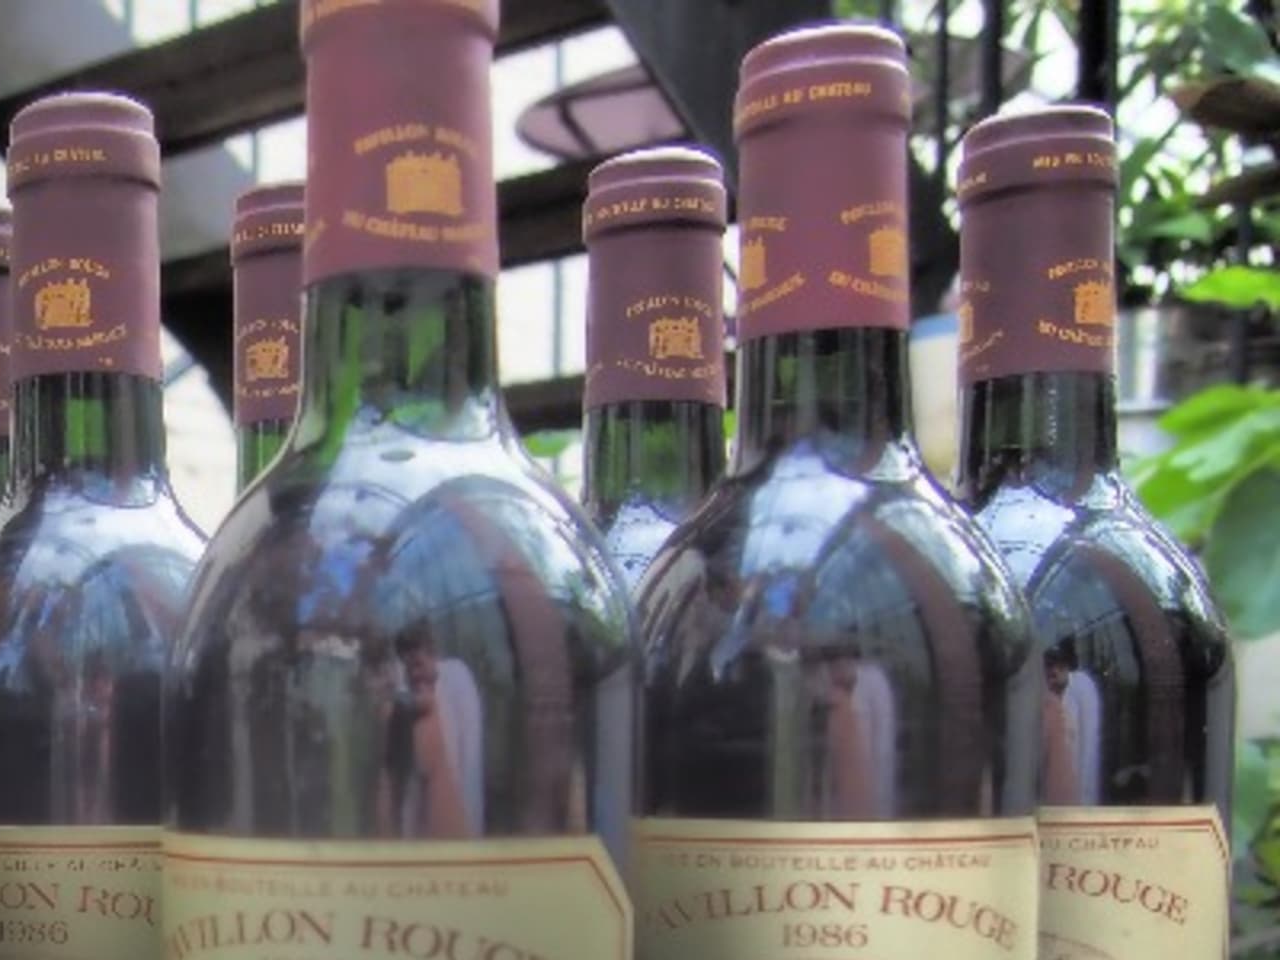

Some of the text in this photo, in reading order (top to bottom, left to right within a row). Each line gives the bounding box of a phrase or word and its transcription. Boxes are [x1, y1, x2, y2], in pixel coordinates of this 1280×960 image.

[879, 884, 1018, 951] ROUGE
[1047, 863, 1189, 926] ROUGE
[782, 923, 870, 949] 1986
